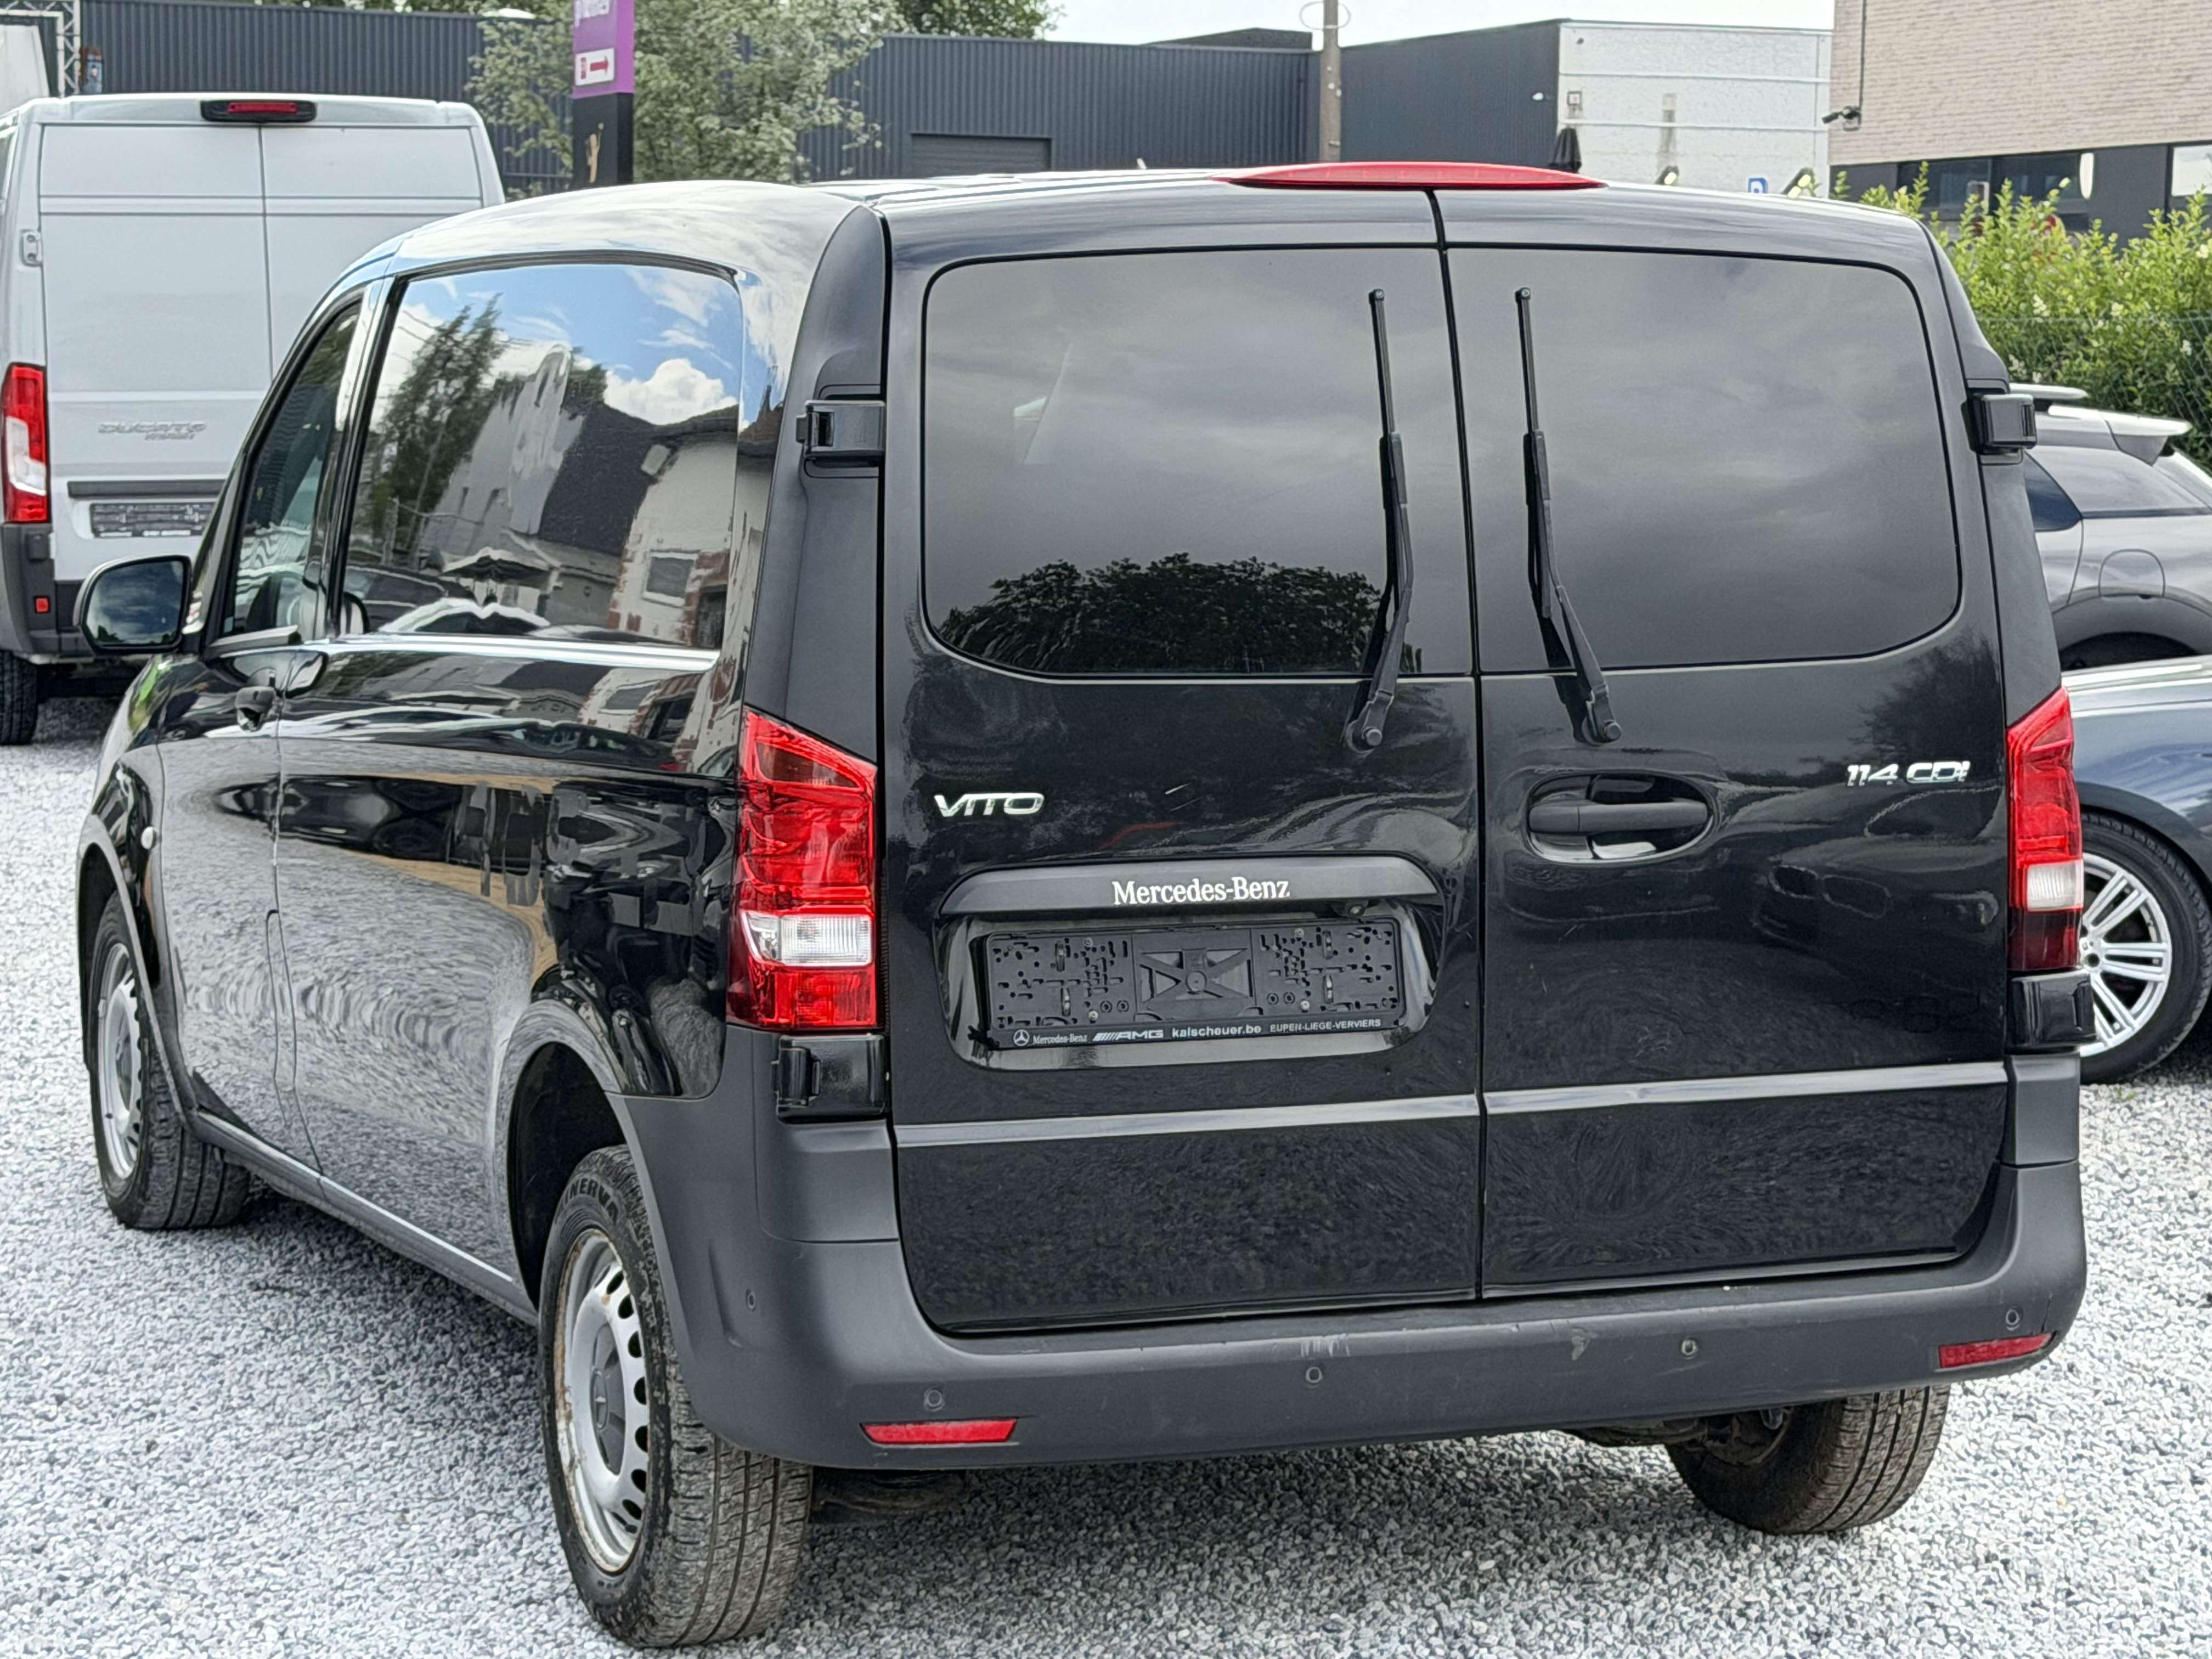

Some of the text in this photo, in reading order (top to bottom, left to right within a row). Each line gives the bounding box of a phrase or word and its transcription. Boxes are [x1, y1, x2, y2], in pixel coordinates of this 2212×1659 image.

[1847, 760, 1971, 786] 114 CDI
[934, 793, 1044, 817] VITO
[1112, 876, 1290, 905] Mercedes-Benz
[1032, 1033, 1088, 1045] Mercedes-Benz
[1115, 1029, 1164, 1041] AMG
[1172, 1025, 1262, 1037] kalscheuer.be
